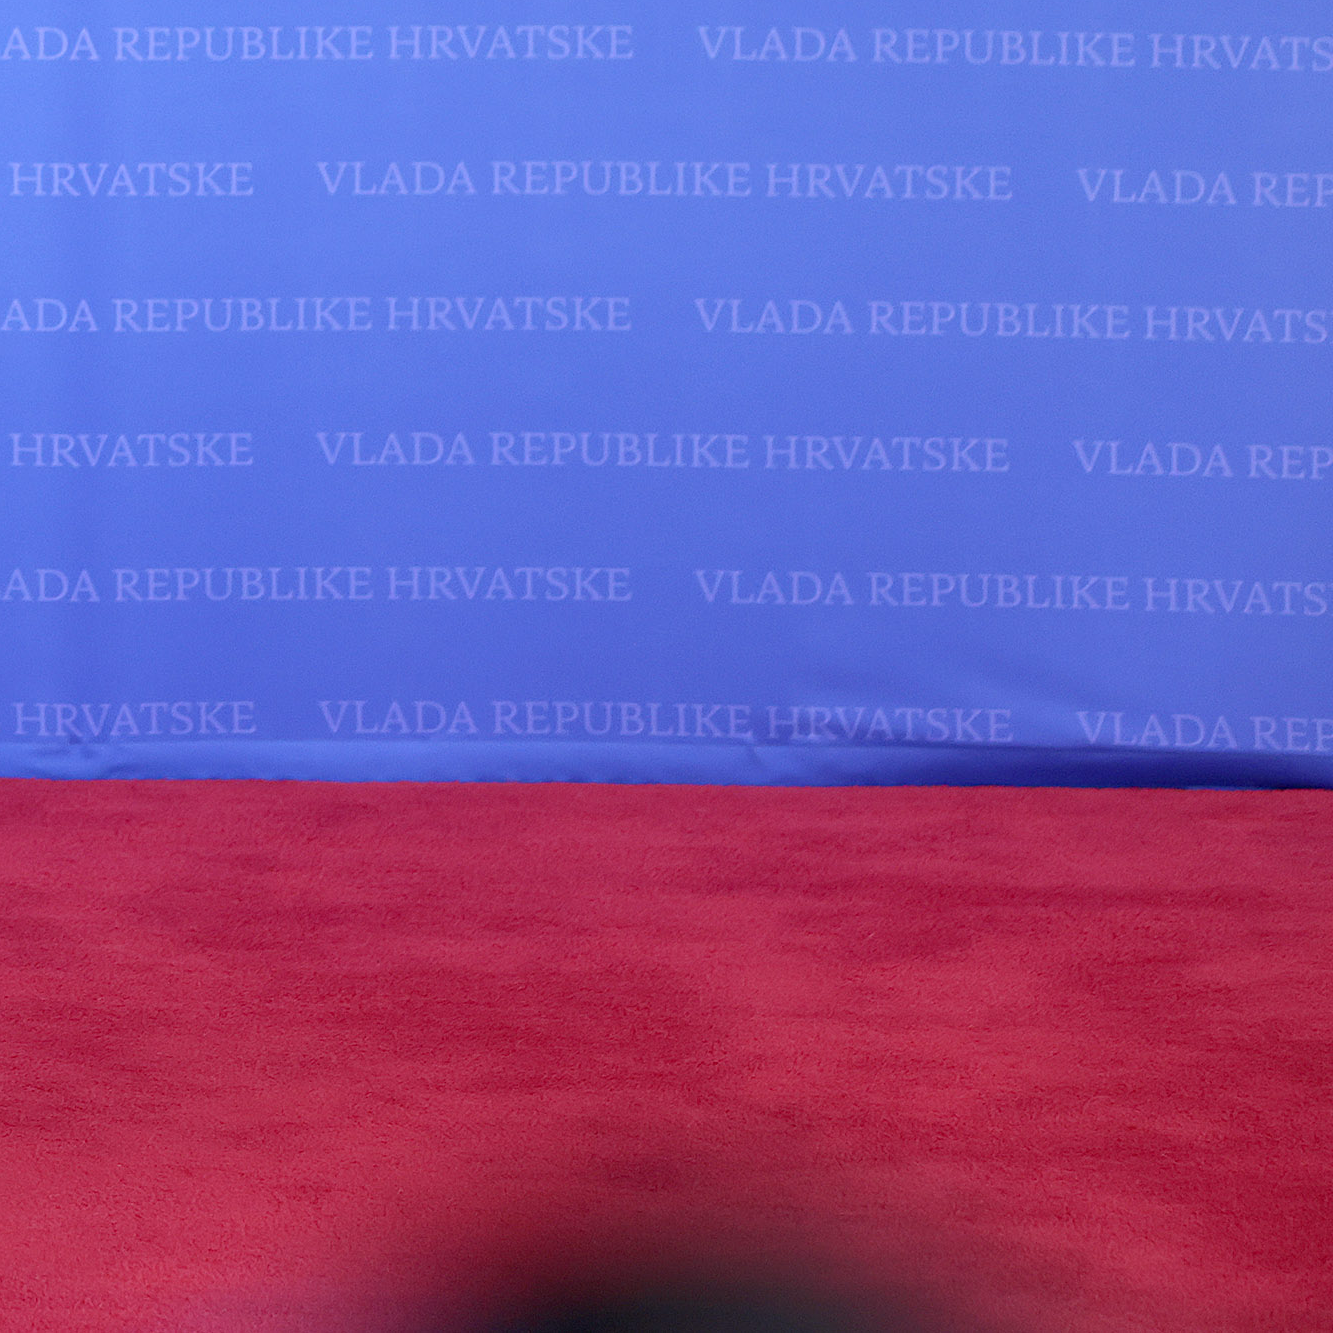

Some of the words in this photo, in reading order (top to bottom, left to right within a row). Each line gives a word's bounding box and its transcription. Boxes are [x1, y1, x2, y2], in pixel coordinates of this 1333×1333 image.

[112, 25, 375, 62] REPUBLIKE
[386, 24, 635, 61] HRVATSKE
[696, 25, 858, 63] VLADA
[870, 27, 1136, 67] REPUBLIKE
[1148, 33, 1333, 72] HRVATS
[8, 161, 255, 197] HRVATSKE
[315, 161, 478, 196] VLADA
[490, 160, 752, 197] REPUBLIKE
[765, 162, 1014, 201] HRVATSKE
[1075, 167, 1238, 206] VLADA
[111, 296, 373, 333] REPUBLIKE
[384, 296, 632, 332] HRVATSKE
[693, 298, 855, 335] VLADA
[867, 300, 1131, 340] REPUBLIKE
[1143, 305, 1333, 344] HRVATS
[8, 432, 255, 468] HRVATSKE
[315, 431, 477, 466] VLADA
[488, 431, 751, 469] REPUBLIKE
[762, 435, 1010, 473] HRVATSKE
[1072, 439, 1234, 478] VLADA
[112, 566, 374, 602] REPUBLIKE
[385, 566, 633, 602] HRVATSKE
[693, 569, 856, 606] VLADA
[866, 572, 1131, 611] REPUBLIKE
[1141, 577, 1333, 617] HRVATS
[12, 700, 257, 737] HRVATSKE
[318, 700, 479, 734] VLADA
[490, 700, 755, 739] REPUBLIKE
[766, 702, 1015, 743] HRVATSKE
[1075, 710, 1240, 750] VLADA
